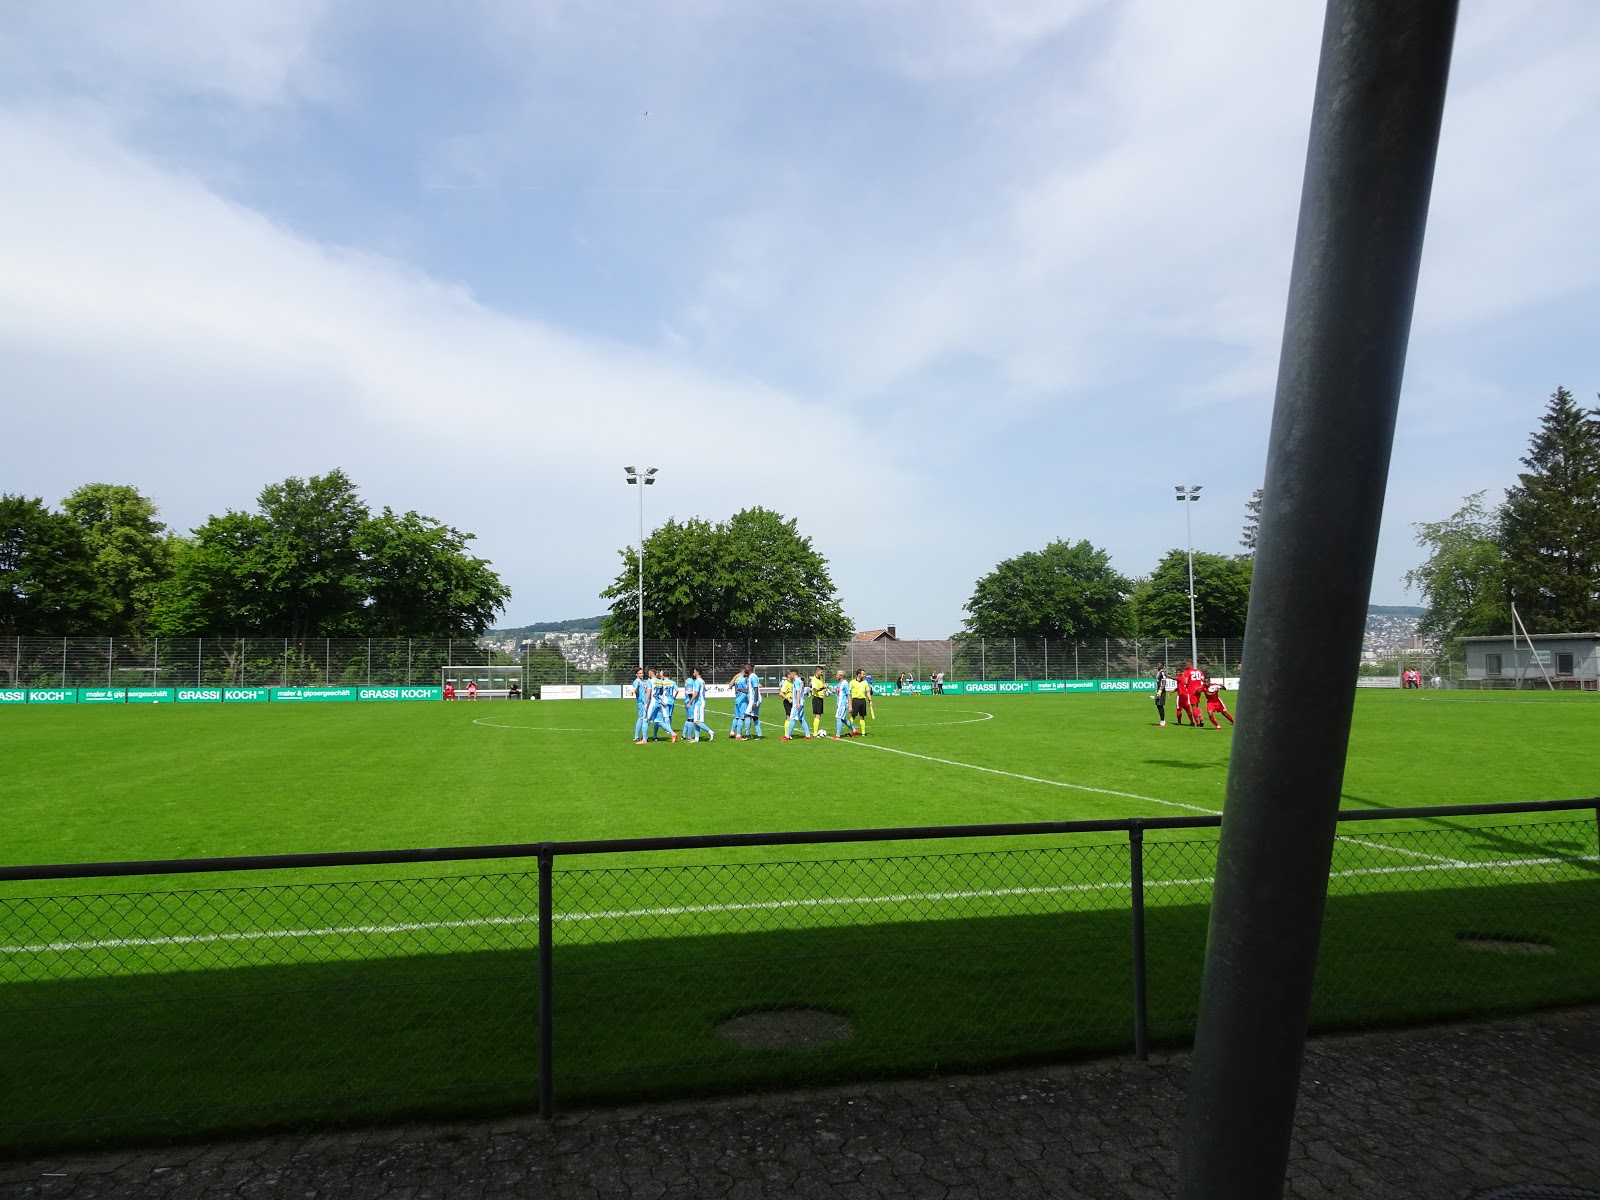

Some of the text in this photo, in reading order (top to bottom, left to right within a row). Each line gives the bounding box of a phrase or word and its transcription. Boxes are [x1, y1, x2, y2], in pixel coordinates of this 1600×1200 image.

[1190, 670, 1201, 681] 20
[965, 683, 997, 692] GRASSI
[999, 683, 1024, 692] KOCH
[1100, 681, 1155, 690] GRASSI KOCH
[30, 691, 65, 701] KOCH
[178, 690, 220, 700] GRASSI
[225, 690, 257, 700] KOCH
[359, 689, 399, 699] GRASSI
[401, 689, 431, 699] KOCH
